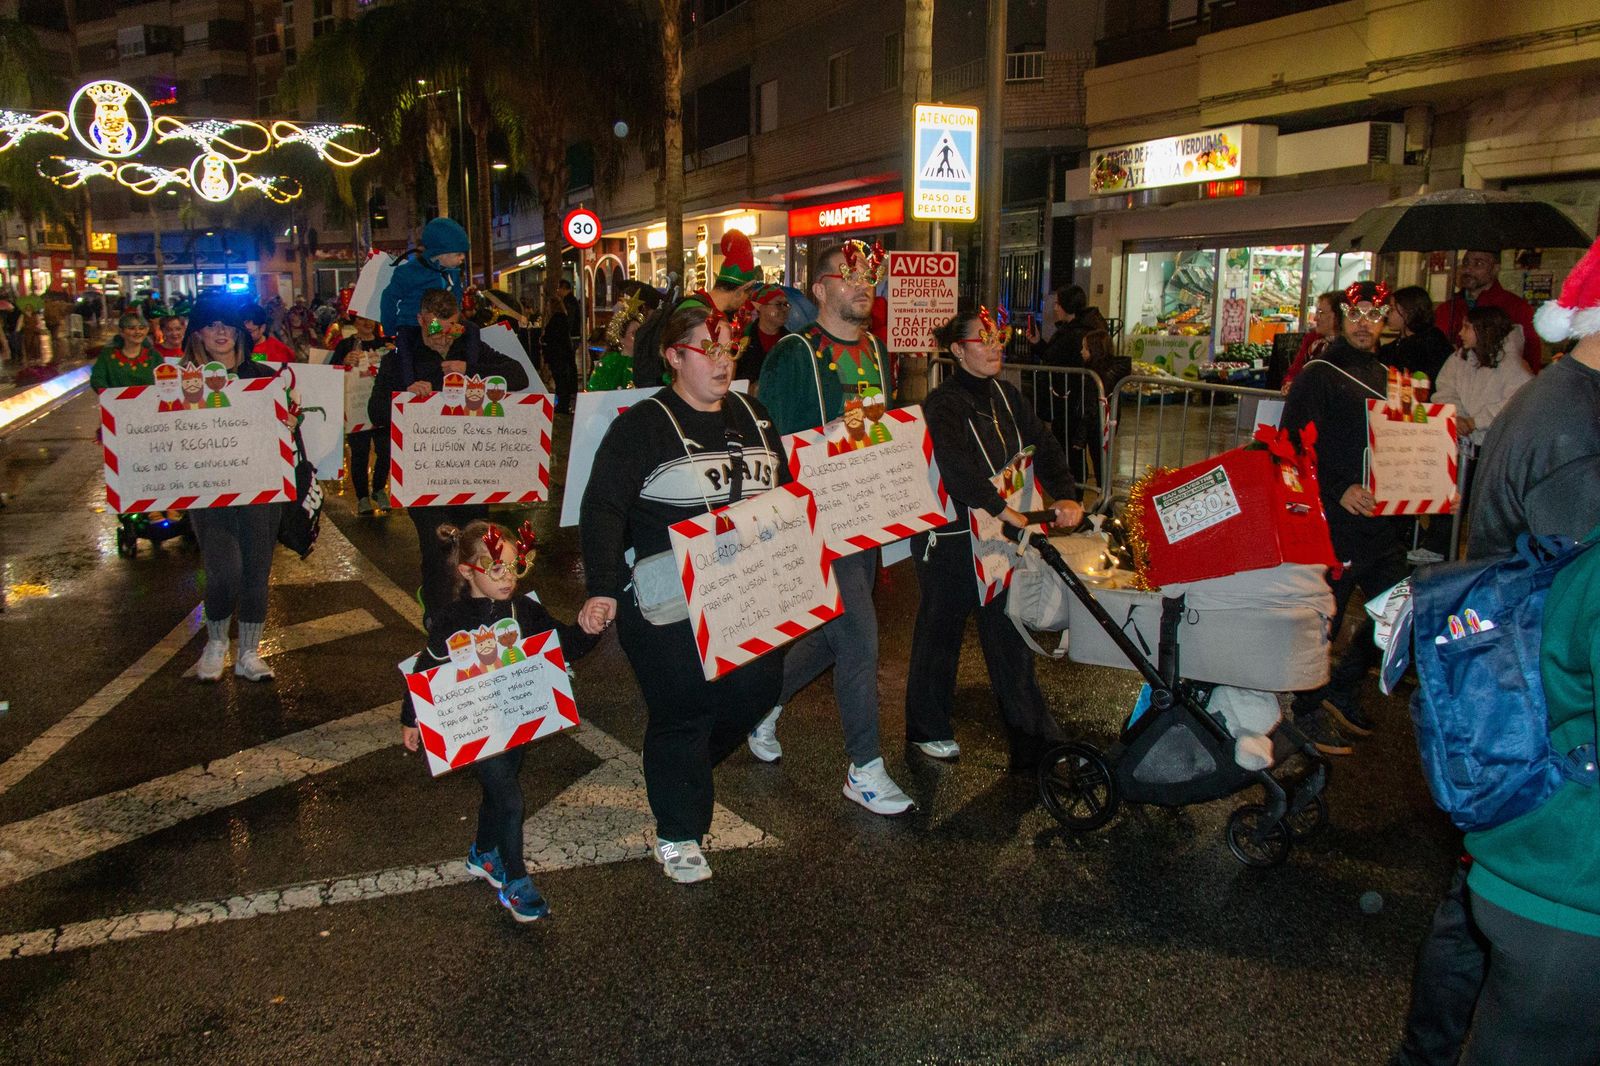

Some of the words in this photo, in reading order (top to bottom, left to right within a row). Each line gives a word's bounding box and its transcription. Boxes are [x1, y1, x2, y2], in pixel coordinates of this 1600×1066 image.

[1135, 147, 1144, 163] DE
[1175, 140, 1180, 156] Y
[1181, 133, 1223, 156] VERDURAS
[922, 193, 950, 202] PASO
[955, 194, 967, 203] DE
[825, 204, 870, 226] MAPFRE
[918, 205, 972, 214] PEATONES
[574, 222, 593, 234] 30
[892, 257, 955, 275] AVISO
[900, 279, 946, 288] PRUEBA
[892, 288, 954, 297] DEPORTIVA
[895, 315, 949, 327] TRÁFICO
[892, 327, 933, 336] CORTA
[894, 338, 917, 347] 17:00
[126, 423, 170, 435] QUERIDOS
[174, 418, 207, 431] REYES
[212, 416, 248, 428] MAGOS
[413, 423, 457, 435] QUERIDOS
[464, 423, 492, 435] REYES
[497, 426, 527, 435] MAGOS
[150, 440, 174, 453] HAY
[181, 437, 238, 451] REGALOS
[413, 442, 426, 452] LA
[432, 438, 466, 452] ILUSIÓN
[472, 442, 483, 452] NO
[485, 443, 497, 452] SE
[500, 442, 533, 452] PIERDE
[132, 462, 151, 473] QUE
[154, 462, 168, 471] NO
[414, 461, 429, 470] SE
[435, 460, 470, 468] RENUEVA
[474, 460, 495, 468] CADA
[500, 456, 518, 468] AÑO
[803, 462, 846, 478] QUERIDOS
[850, 452, 878, 466] REYES
[189, 481, 200, 489] DE
[832, 482, 850, 491] ESTA
[856, 473, 880, 485] NOCHE
[855, 503, 870, 512] LAS
[1175, 494, 1222, 527] 630
[831, 514, 873, 534] FAMILIAS
[695, 542, 746, 571] QUERIDO
[698, 580, 716, 597] QUE
[719, 573, 738, 587] ESTA
[742, 560, 764, 575] NOCHE
[703, 593, 733, 611] TRAIGA
[772, 569, 779, 577] A
[783, 557, 805, 572] TODAS
[740, 598, 756, 613] LAS
[720, 607, 771, 643] FAMILIAS
[434, 685, 475, 705] QUERIDOS
[478, 675, 508, 691] REYES
[436, 707, 454, 718] QUE
[457, 700, 474, 711] ESTA
[479, 690, 501, 703] NOCHE
[440, 715, 468, 731] TRAIGA
[512, 691, 532, 702] TODAS
[474, 716, 489, 725] LAS
[453, 726, 489, 743] FAMILIAS
